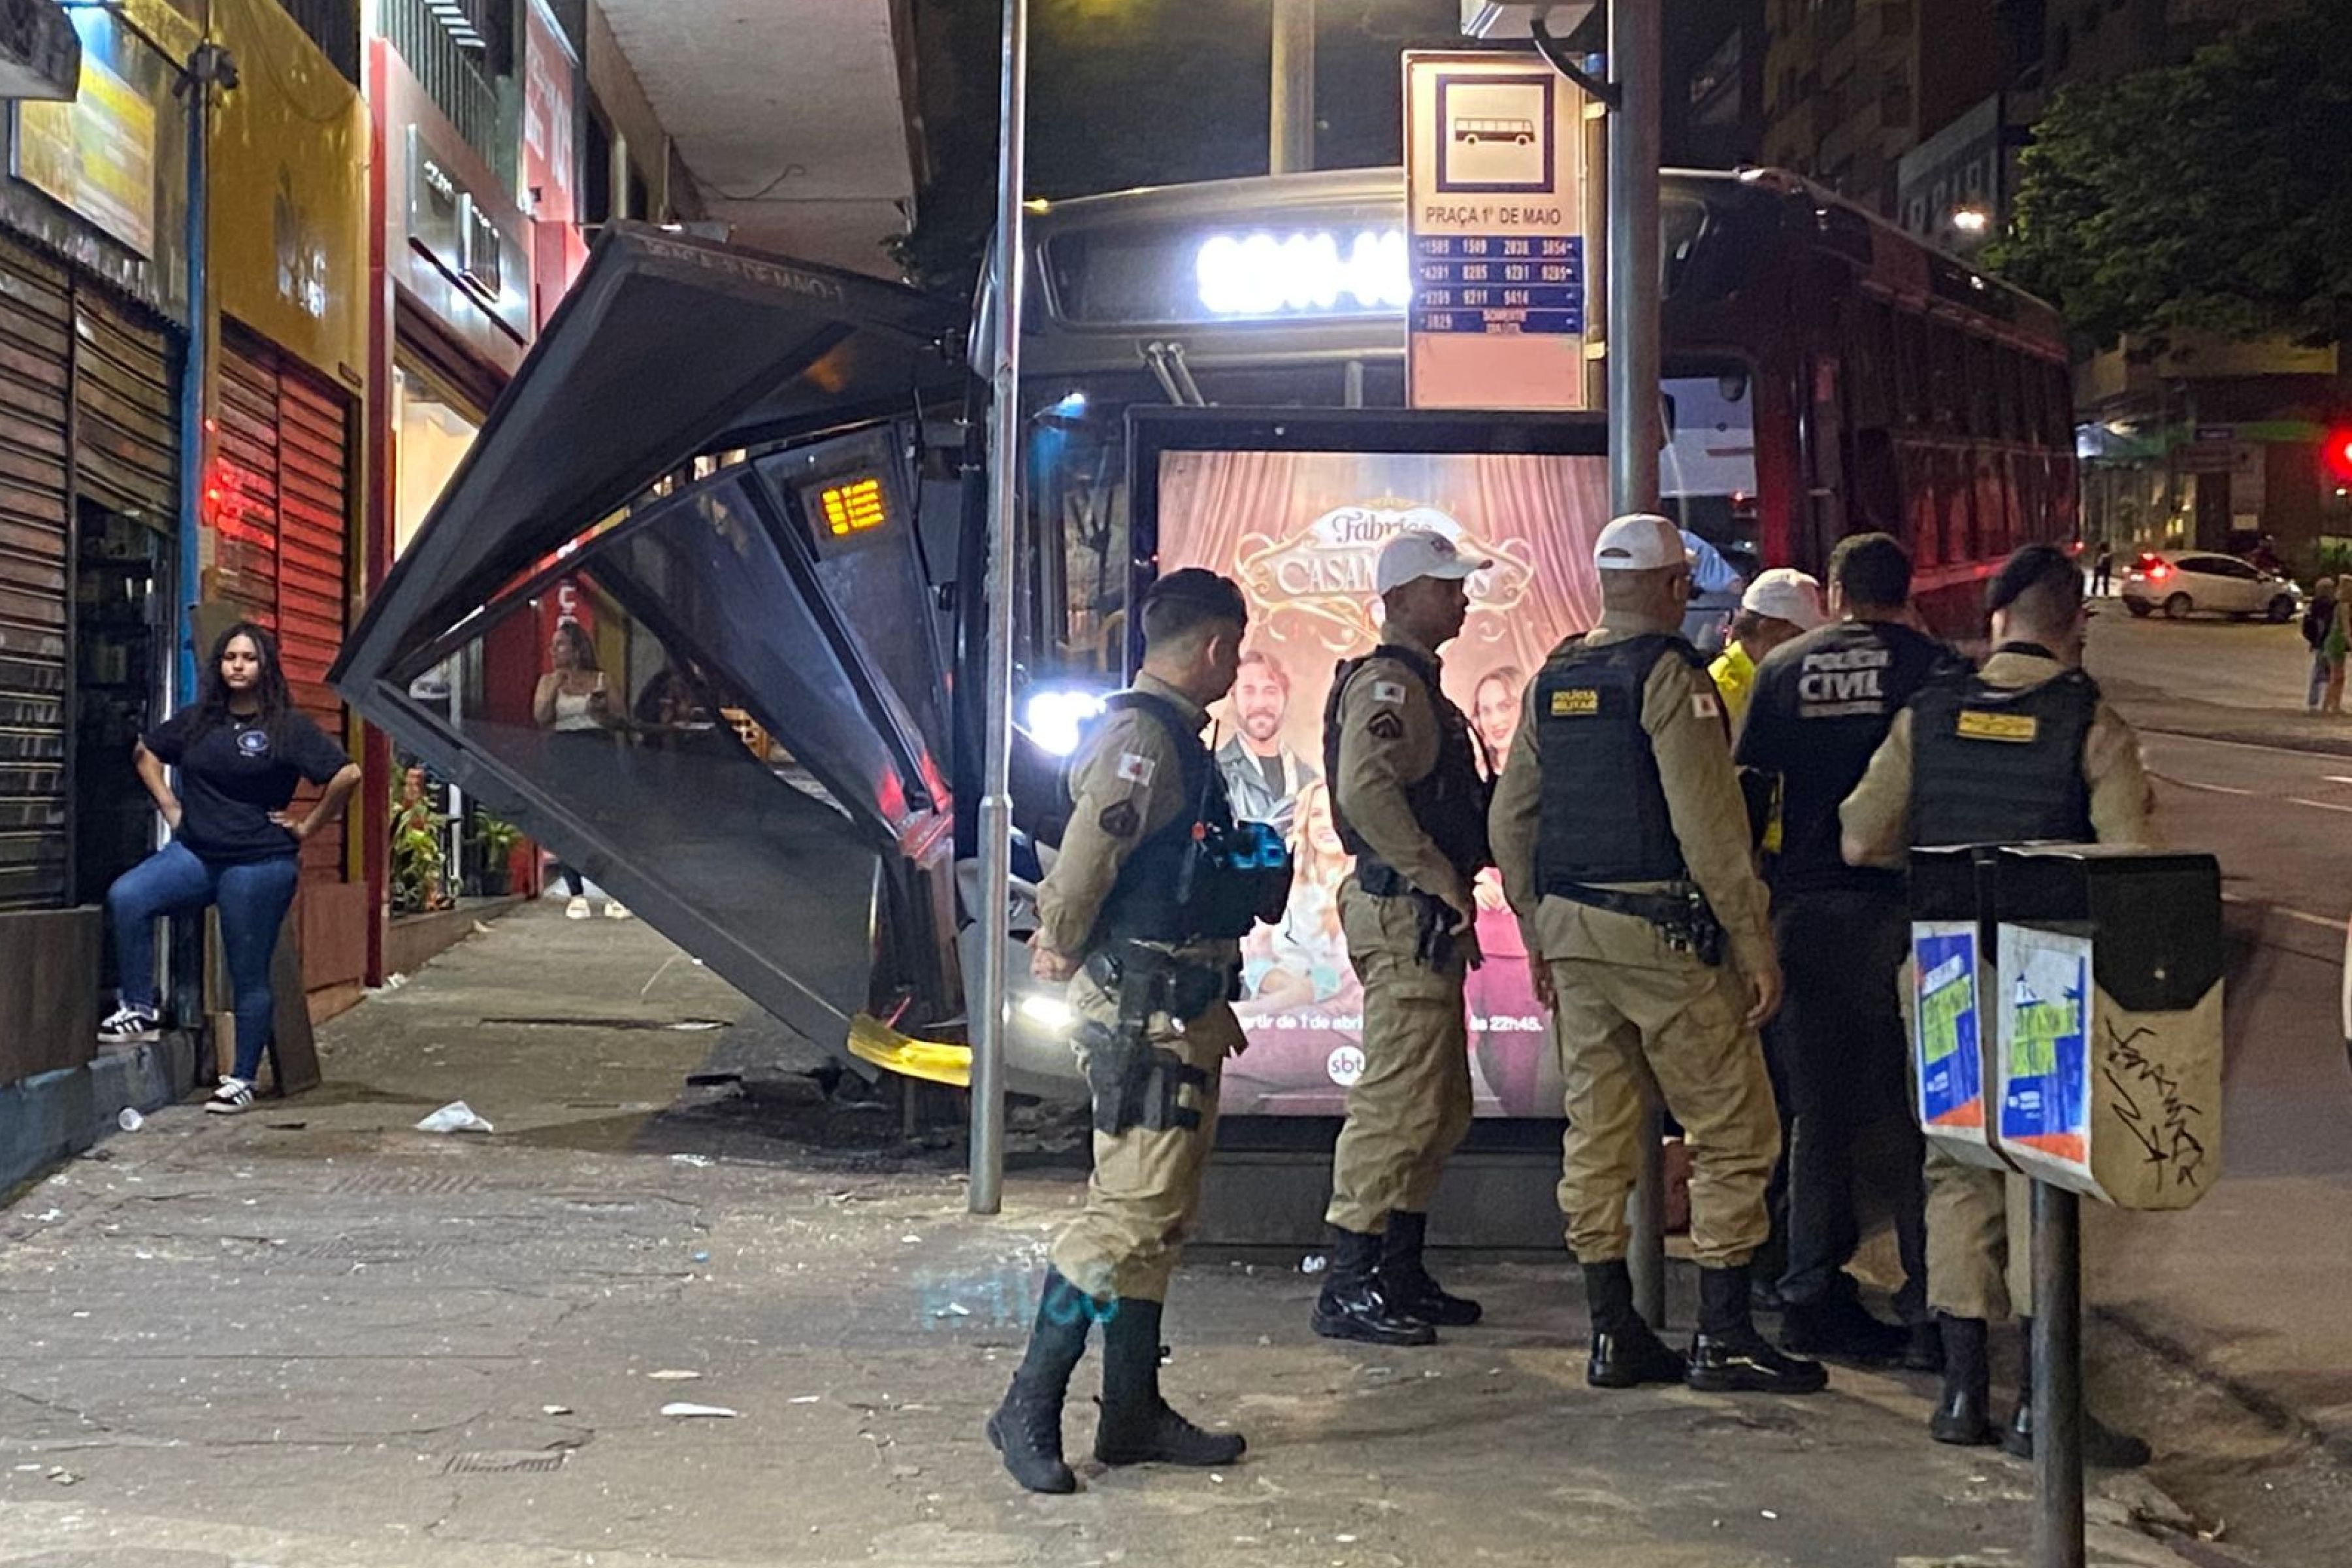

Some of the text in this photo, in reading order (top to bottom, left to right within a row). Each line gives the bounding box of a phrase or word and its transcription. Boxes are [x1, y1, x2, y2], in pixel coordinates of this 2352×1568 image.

[1426, 206, 1478, 227] PRAÇA
[1499, 207, 1519, 224] DE
[1523, 207, 1561, 225] MAIO
[1798, 669, 1884, 701] CIVIL
[1330, 1052, 1365, 1073] sbt
